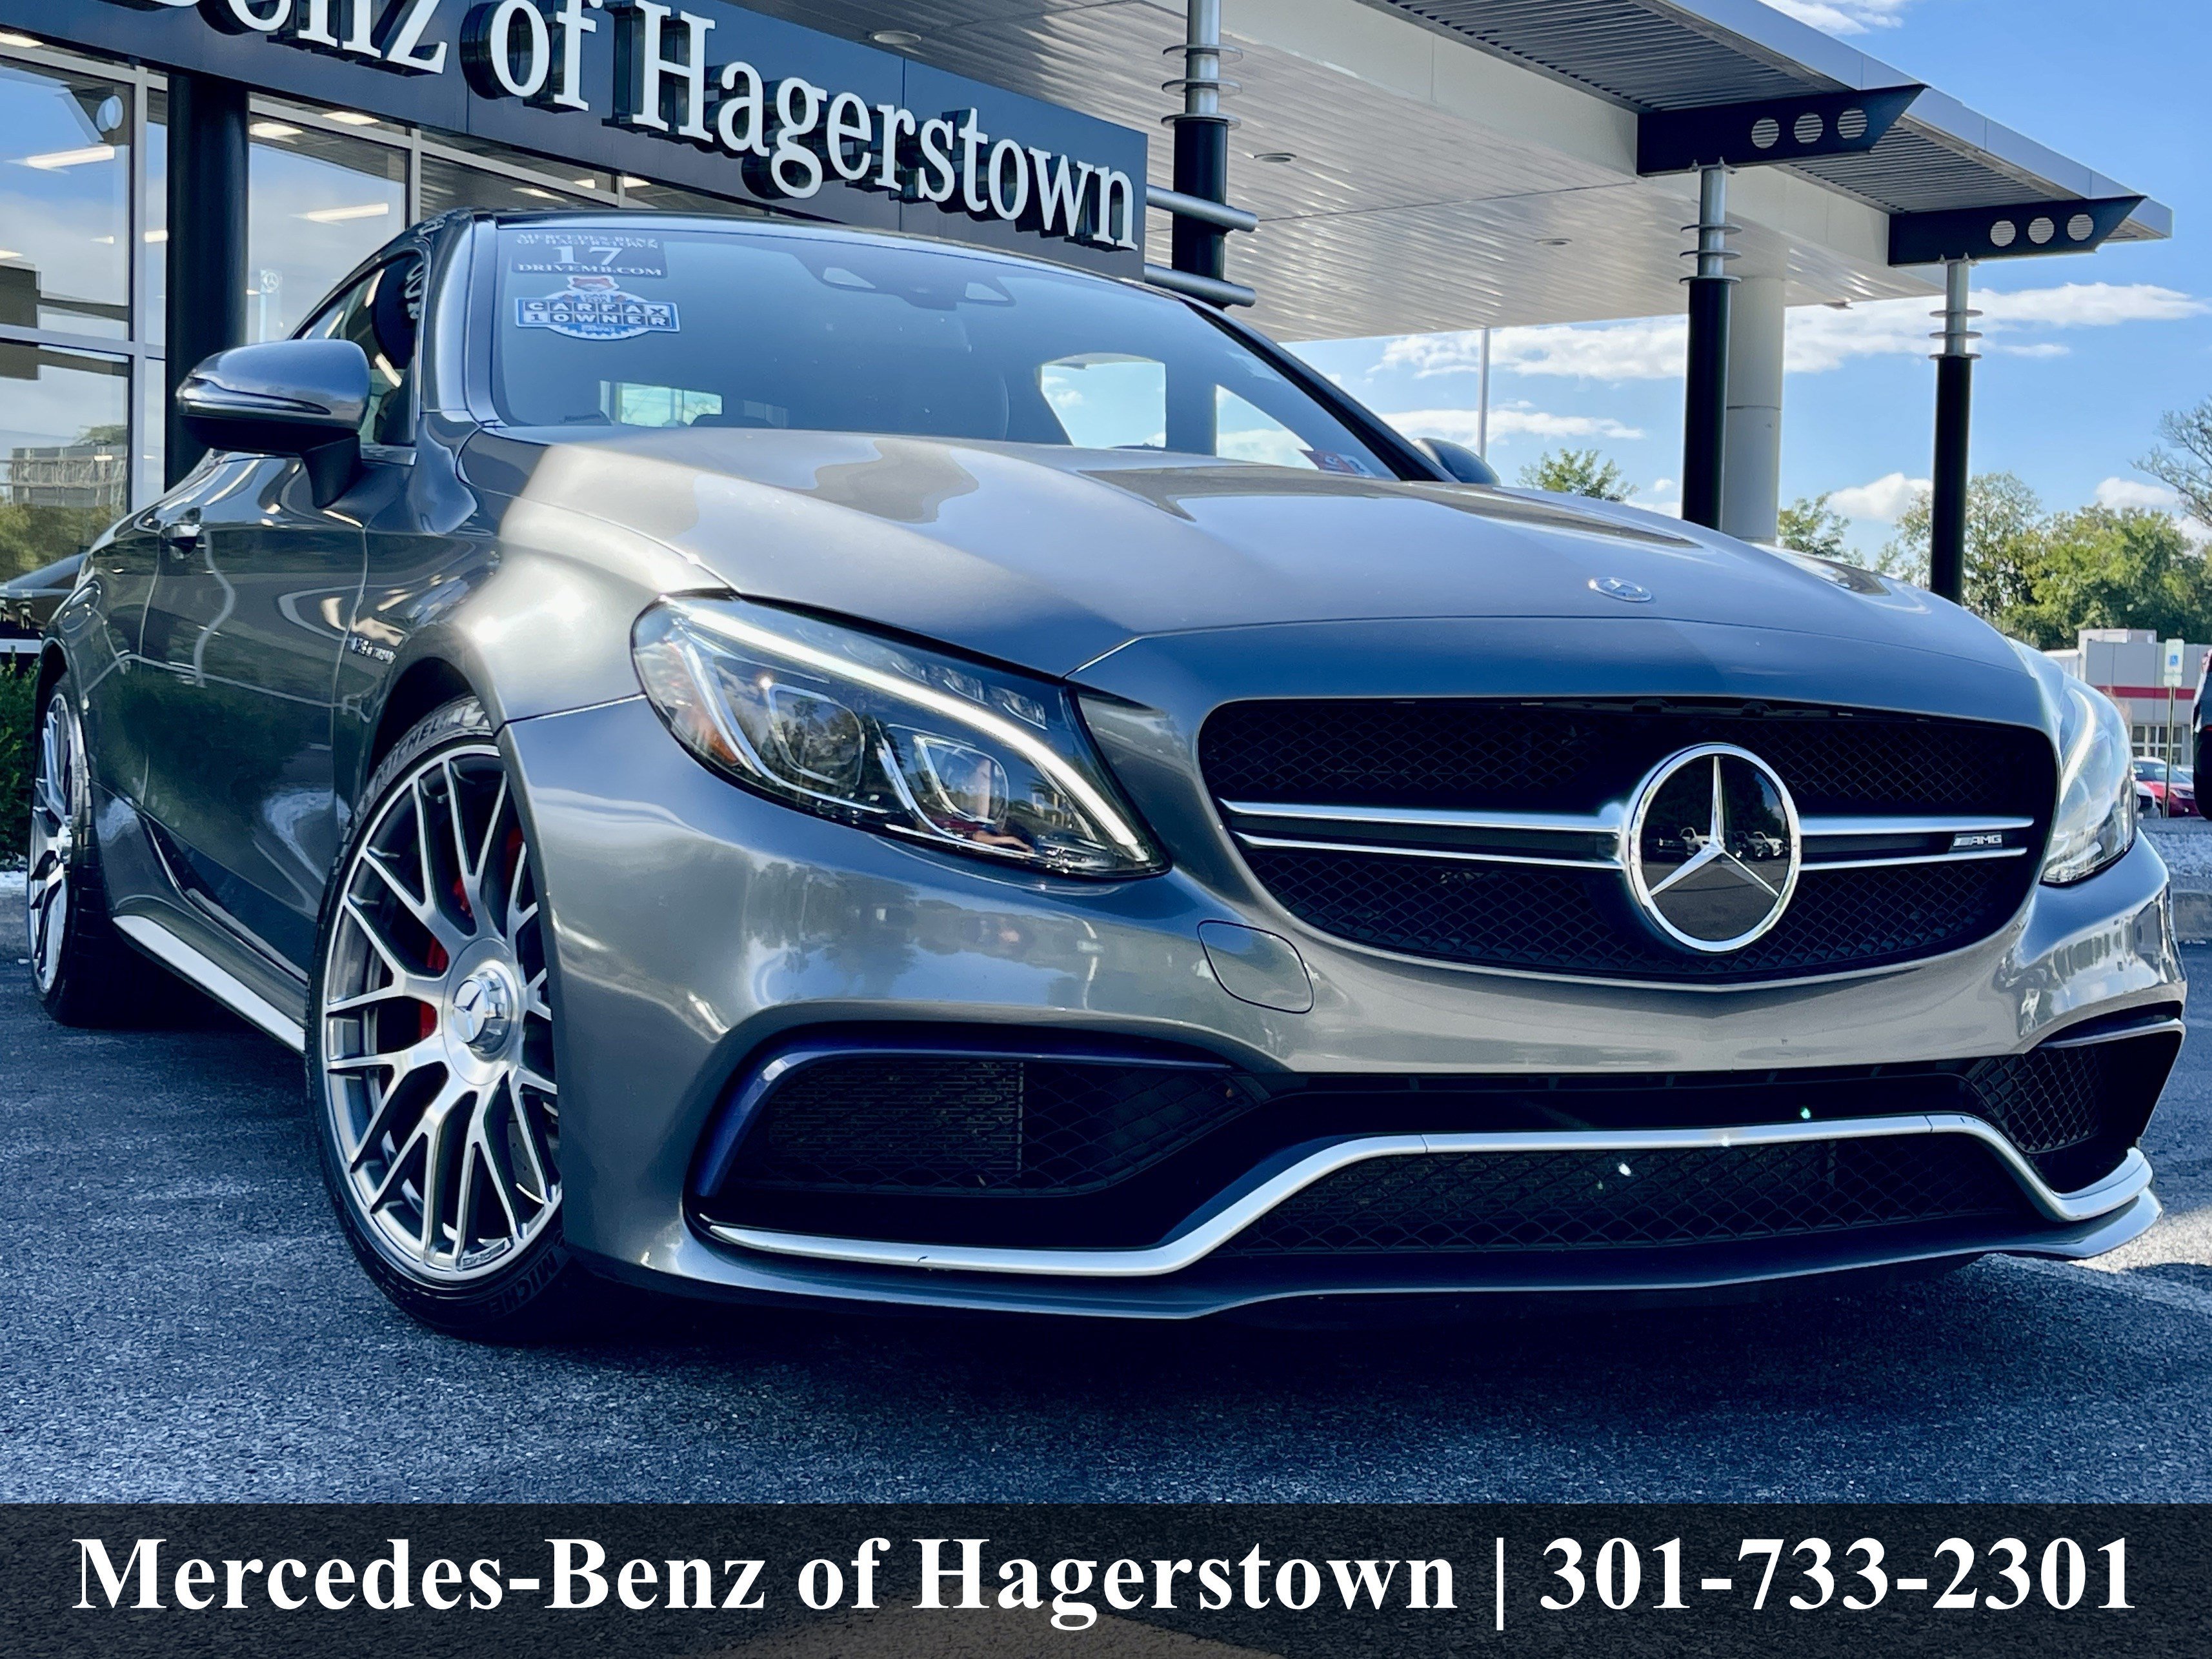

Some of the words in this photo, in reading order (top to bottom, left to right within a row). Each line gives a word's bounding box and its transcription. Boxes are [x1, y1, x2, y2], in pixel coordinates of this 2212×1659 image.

[489, 0, 603, 112] of
[632, 0, 1138, 250] Hagerstown
[527, 301, 667, 317] CARFAX
[552, 313, 667, 326] OWNER
[1967, 834, 2002, 846] AMG
